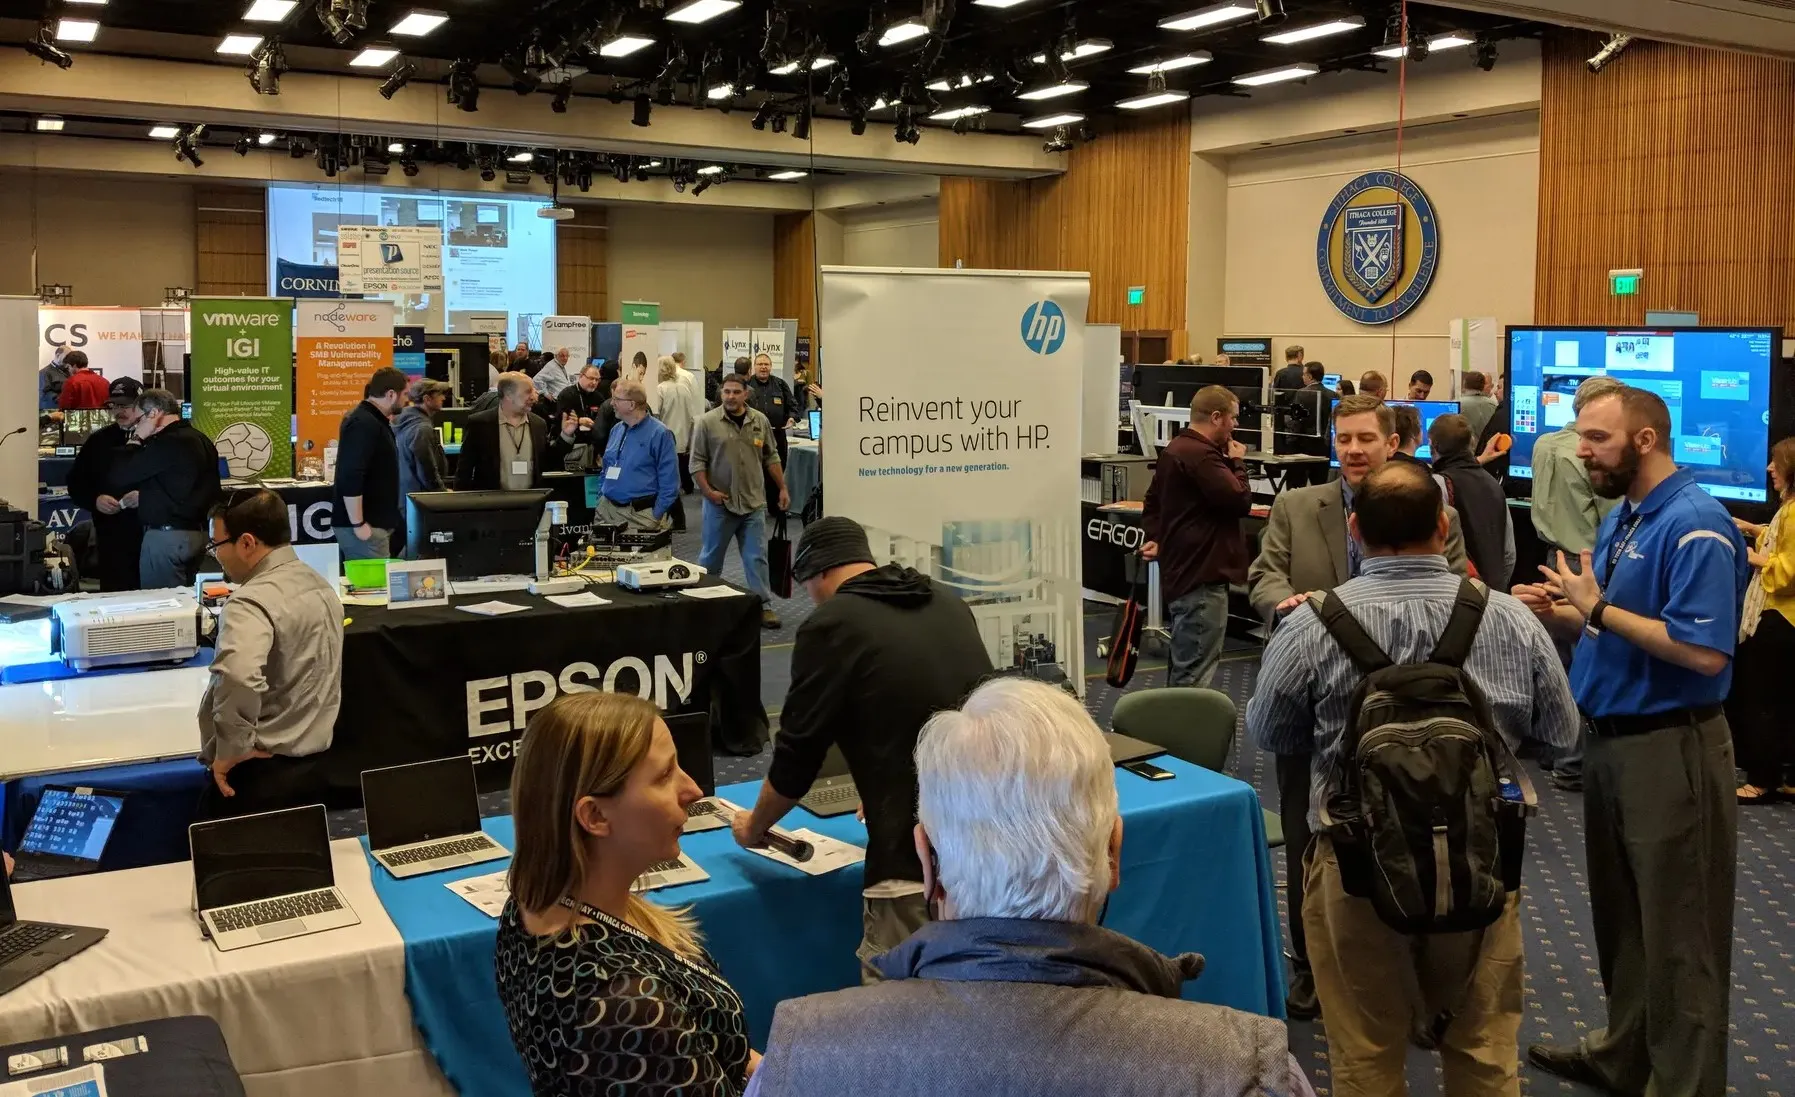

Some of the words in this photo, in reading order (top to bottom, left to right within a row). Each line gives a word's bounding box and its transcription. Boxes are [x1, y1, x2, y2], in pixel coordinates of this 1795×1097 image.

[1332, 176, 1370, 210] ITHACA
[1376, 173, 1420, 204] COLEGE
[1350, 211, 1370, 219] ITHACA
[1372, 209, 1396, 217] COLLEGE
[202, 313, 279, 326] vmware
[314, 312, 376, 322] nodeware
[1374, 309, 1389, 320] TO
[44, 324, 88, 347] CS
[98, 332, 116, 340] WE
[226, 338, 260, 358] IGI
[732, 340, 746, 350] Lynx
[762, 342, 780, 352] Lynx
[330, 351, 382, 360] Vulnerability
[318, 360, 374, 368] Management.
[214, 366, 260, 376] High-value
[860, 396, 964, 422] Reinvent
[971, 400, 1022, 424] your
[860, 434, 952, 459] campus
[960, 425, 1008, 452] with
[1017, 424, 1050, 450] HP.
[858, 468, 876, 476] New
[878, 464, 924, 476] technology
[926, 464, 938, 474] for
[946, 464, 962, 472] new
[964, 462, 1010, 474] generation.
[46, 508, 80, 528] AV
[596, 910, 620, 930] ITHACA
[620, 924, 650, 942] COLLEGE
